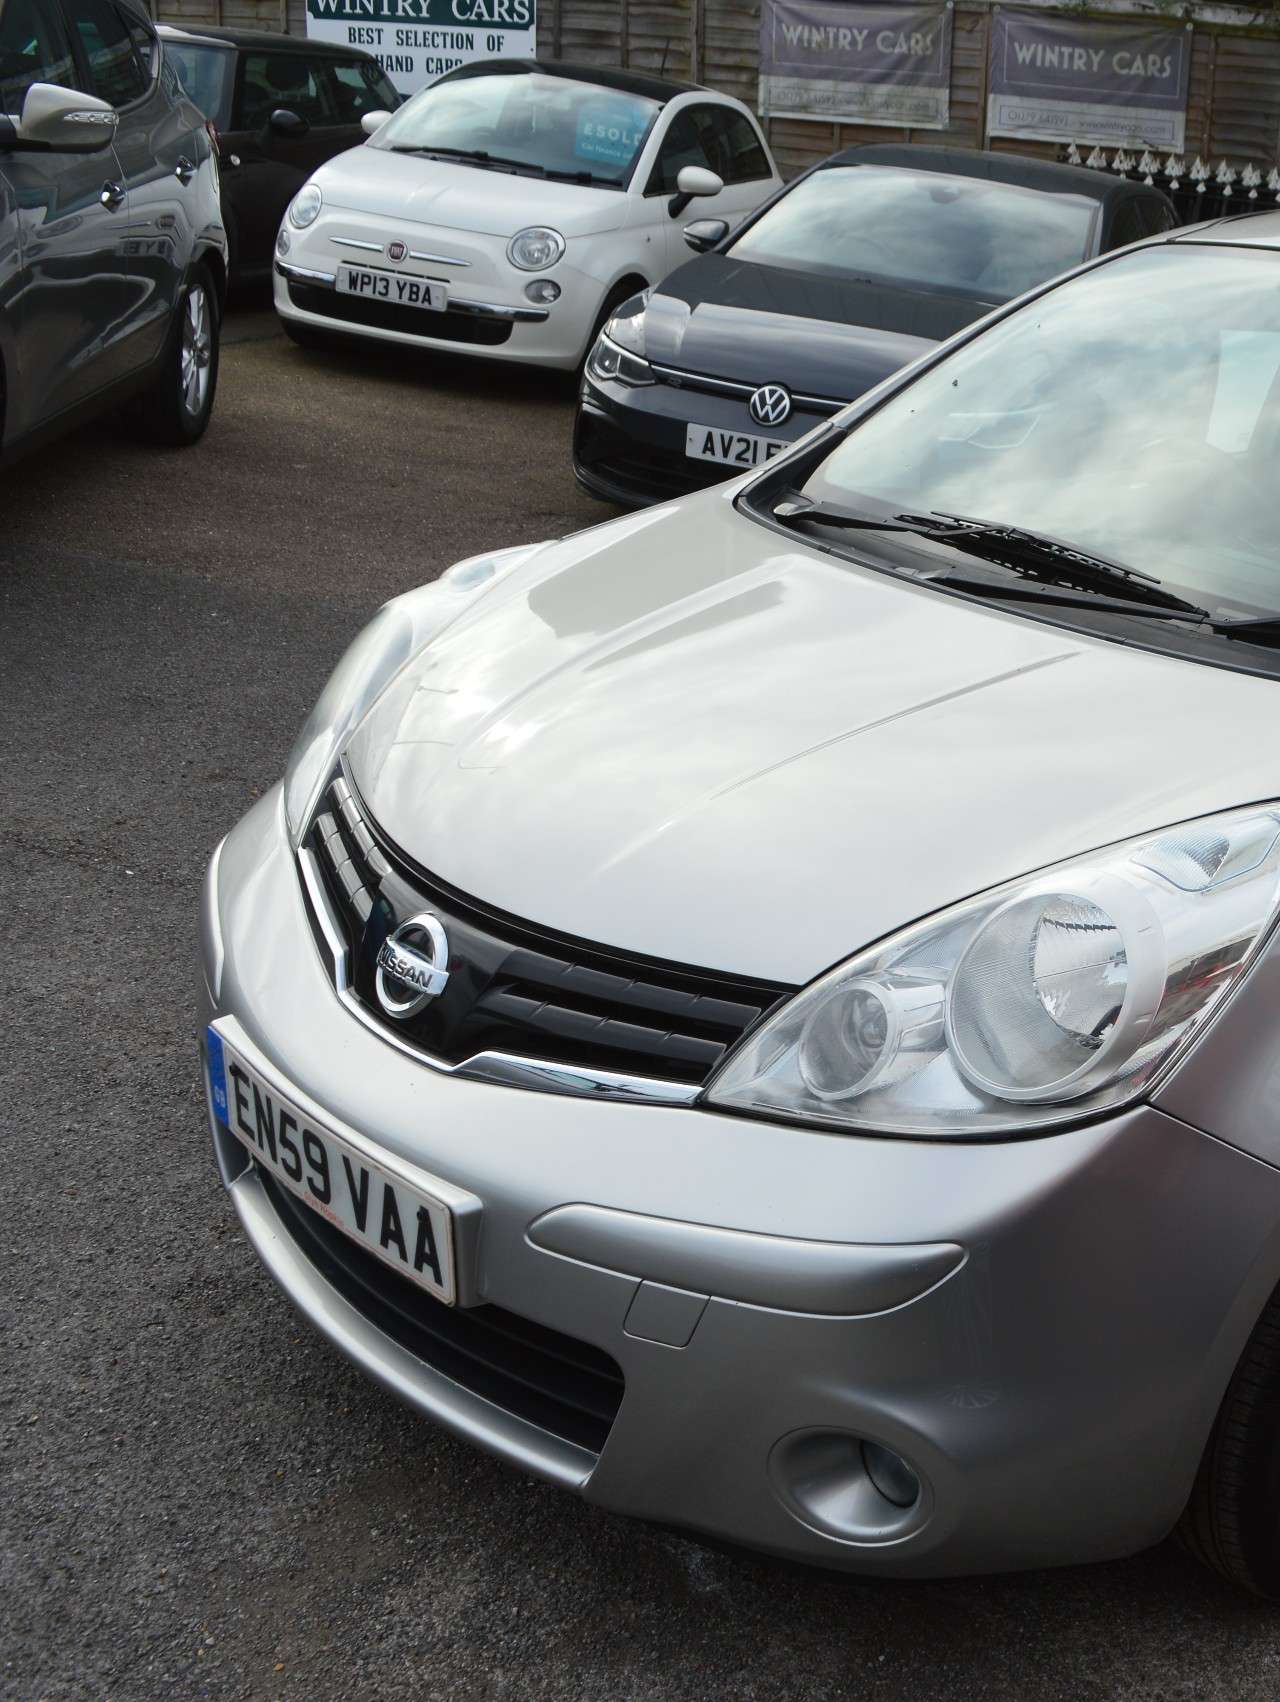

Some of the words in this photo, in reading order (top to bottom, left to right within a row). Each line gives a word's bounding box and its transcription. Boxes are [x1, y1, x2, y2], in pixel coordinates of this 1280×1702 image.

[452, 0, 530, 24] CARS
[348, 26, 384, 46] BEST
[396, 29, 475, 51] SELECTION
[486, 34, 505, 52] OF
[780, 22, 869, 53] WINTRY
[876, 29, 934, 56] CARS
[1013, 41, 1105, 73] WINTRY
[1112, 51, 1173, 79] CARS
[348, 270, 390, 297] WP13
[396, 279, 433, 306] YBA
[702, 431, 759, 465] AV21
[230, 1064, 332, 1205] EN59
[342, 1155, 444, 1288] VAA
